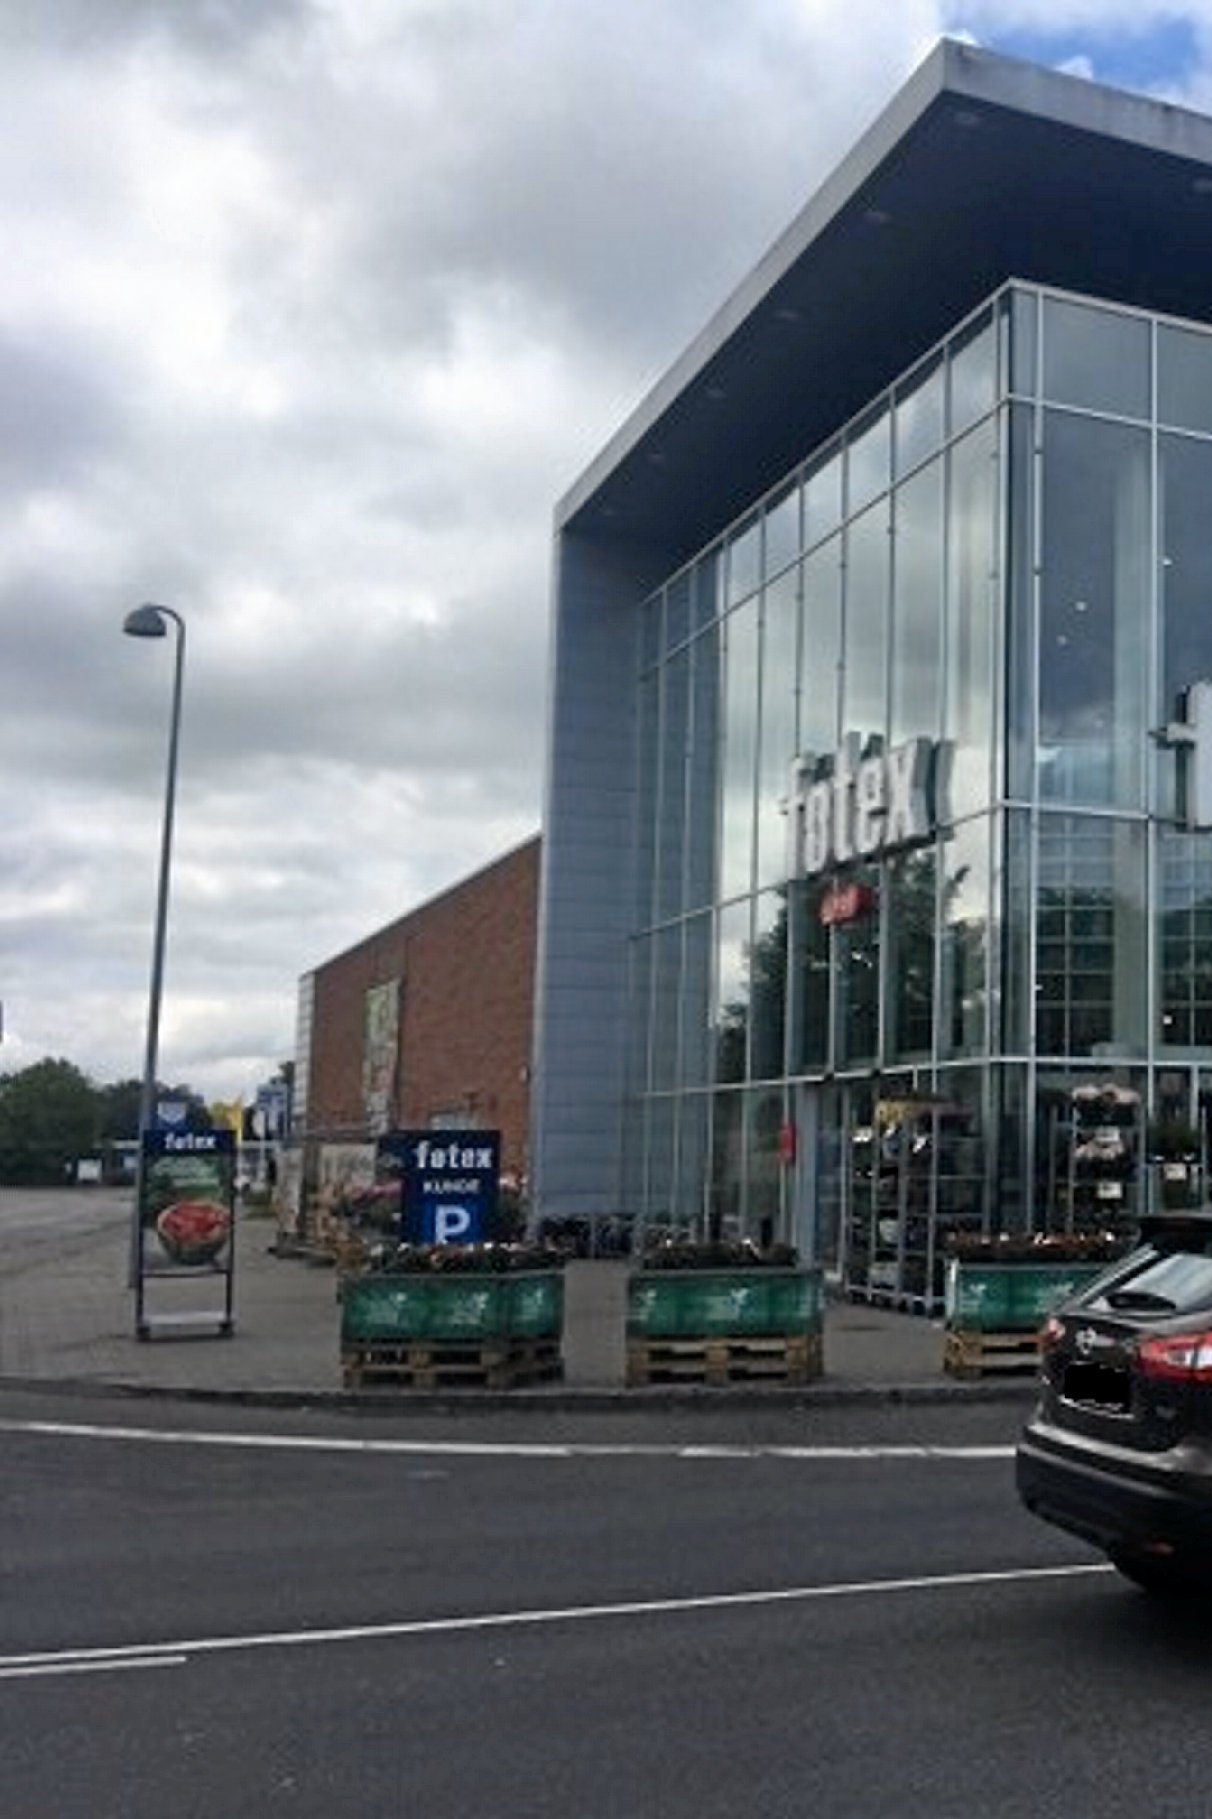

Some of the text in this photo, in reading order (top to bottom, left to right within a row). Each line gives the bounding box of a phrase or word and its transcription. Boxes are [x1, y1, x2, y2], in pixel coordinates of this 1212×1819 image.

[782, 731, 943, 882] føtex
[413, 1140, 492, 1169] føtex
[435, 1204, 471, 1244] P
